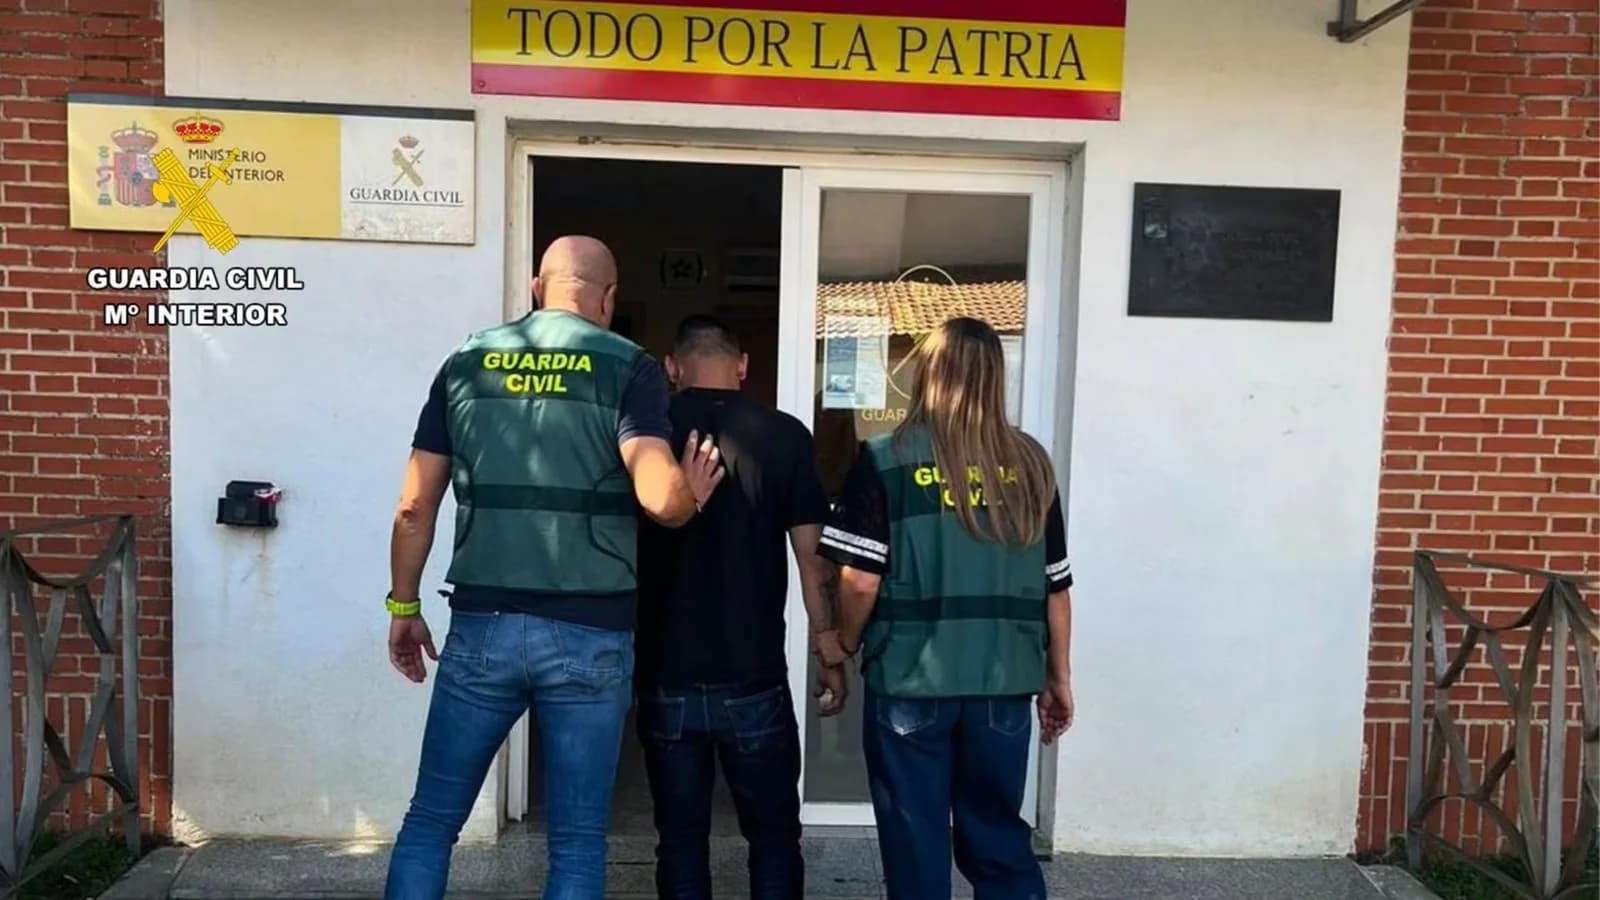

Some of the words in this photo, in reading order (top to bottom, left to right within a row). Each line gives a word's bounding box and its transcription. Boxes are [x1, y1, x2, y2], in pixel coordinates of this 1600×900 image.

[507, 7, 663, 62] TODO
[682, 15, 793, 68] POR
[810, 21, 877, 72] LA
[896, 26, 1087, 81] PATRIA
[188, 148, 267, 164] MINISTERIO
[188, 166, 213, 179] DEL
[222, 167, 286, 182] NTERIOR
[349, 187, 420, 202] GUARDIA
[423, 189, 464, 204] CIVIL
[483, 352, 593, 373] GUARDIA
[504, 373, 568, 394] CIVIL
[862, 407, 908, 421] GUAR
[914, 465, 1018, 486] GURIA
